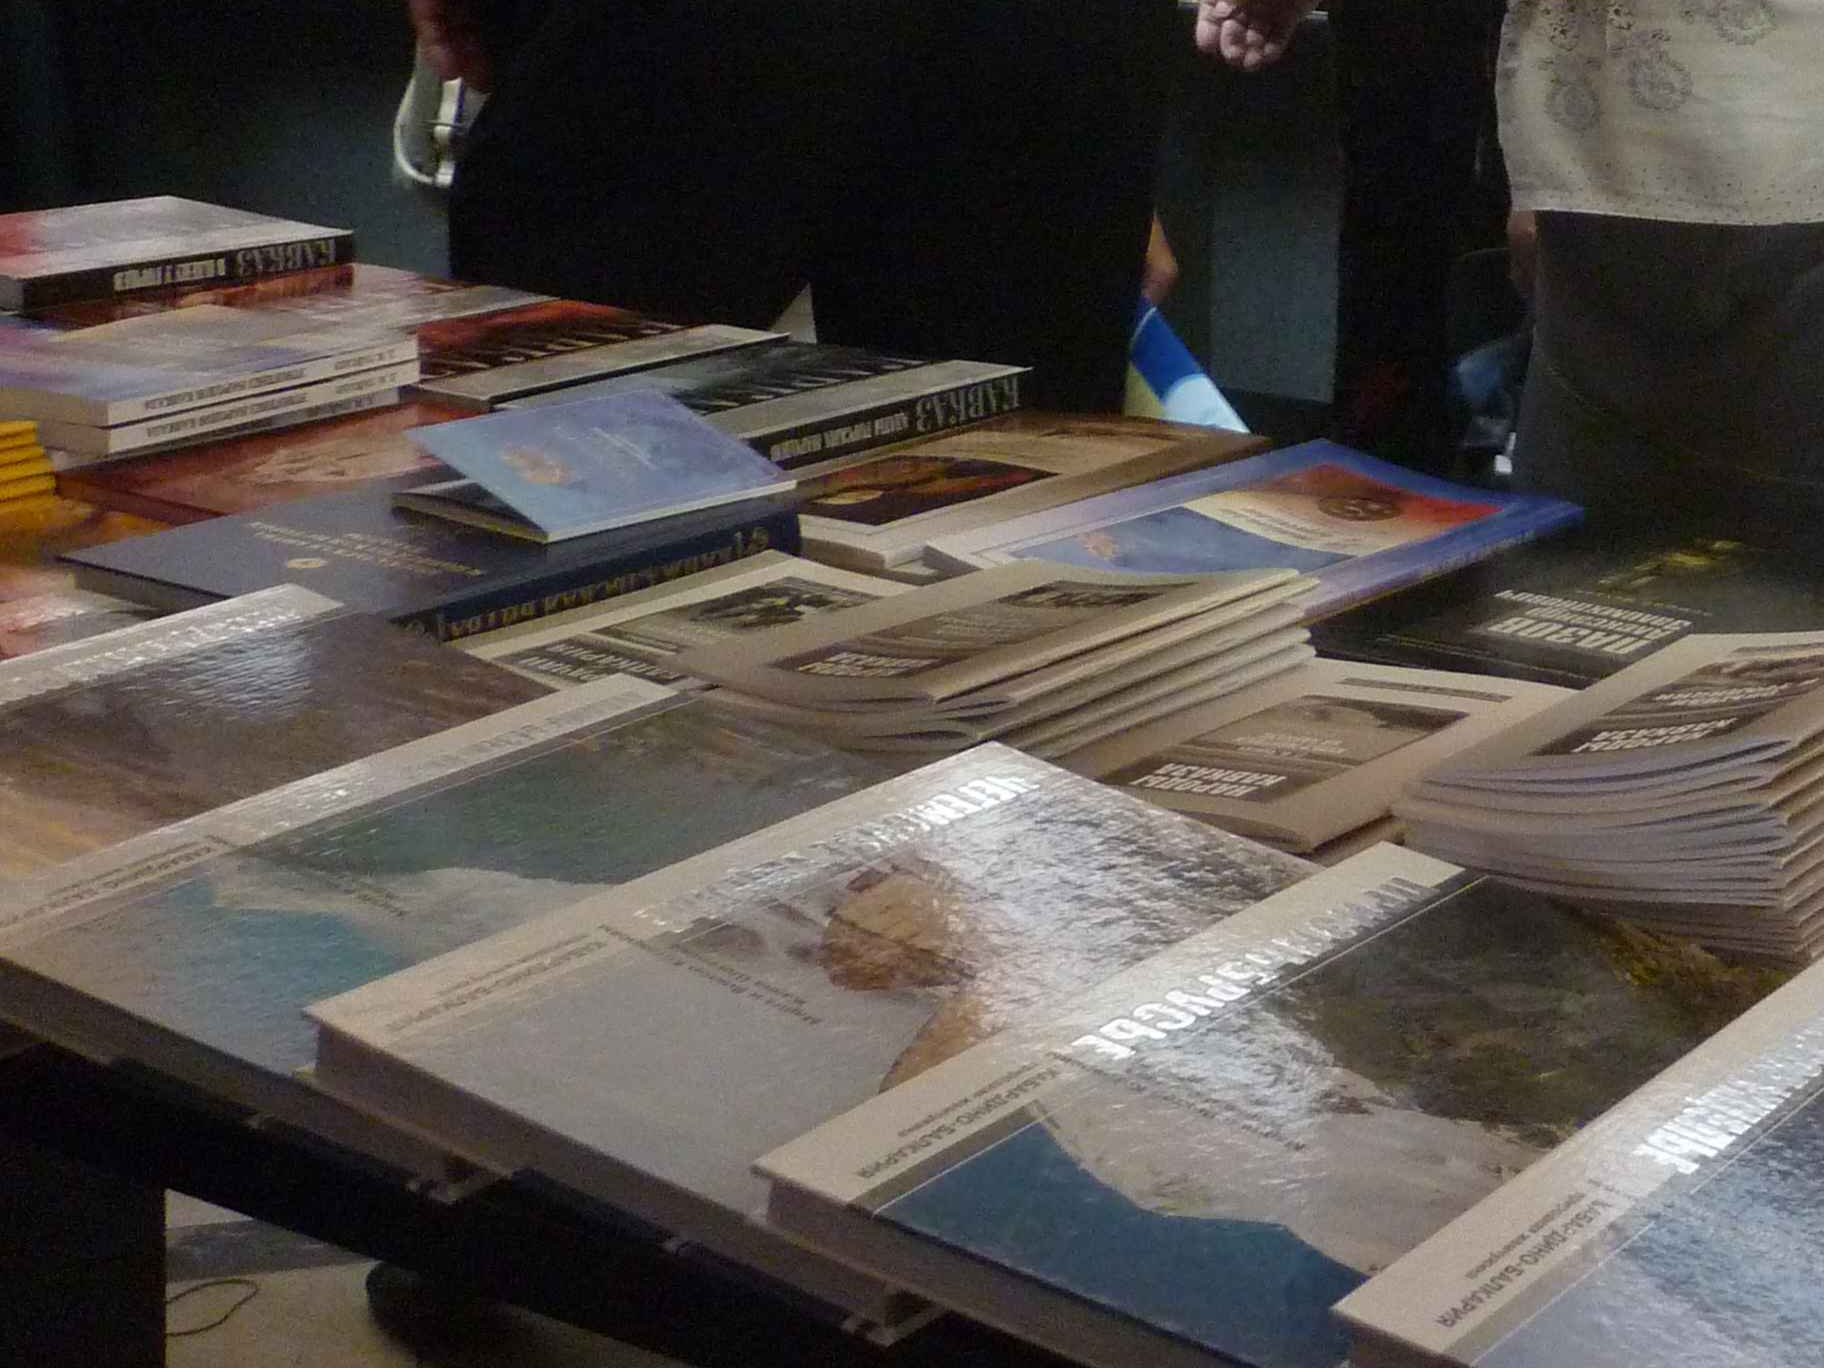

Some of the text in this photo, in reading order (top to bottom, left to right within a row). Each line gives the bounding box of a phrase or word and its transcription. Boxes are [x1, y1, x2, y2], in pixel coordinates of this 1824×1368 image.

[914, 376, 1021, 434] КАВКАЗ
[1128, 773, 1258, 798] НАРОДЫ
[1153, 762, 1288, 788] КАВКАЗА
[858, 1064, 1063, 1179] КАБАРДИНО-БАЛКАРИЯ
